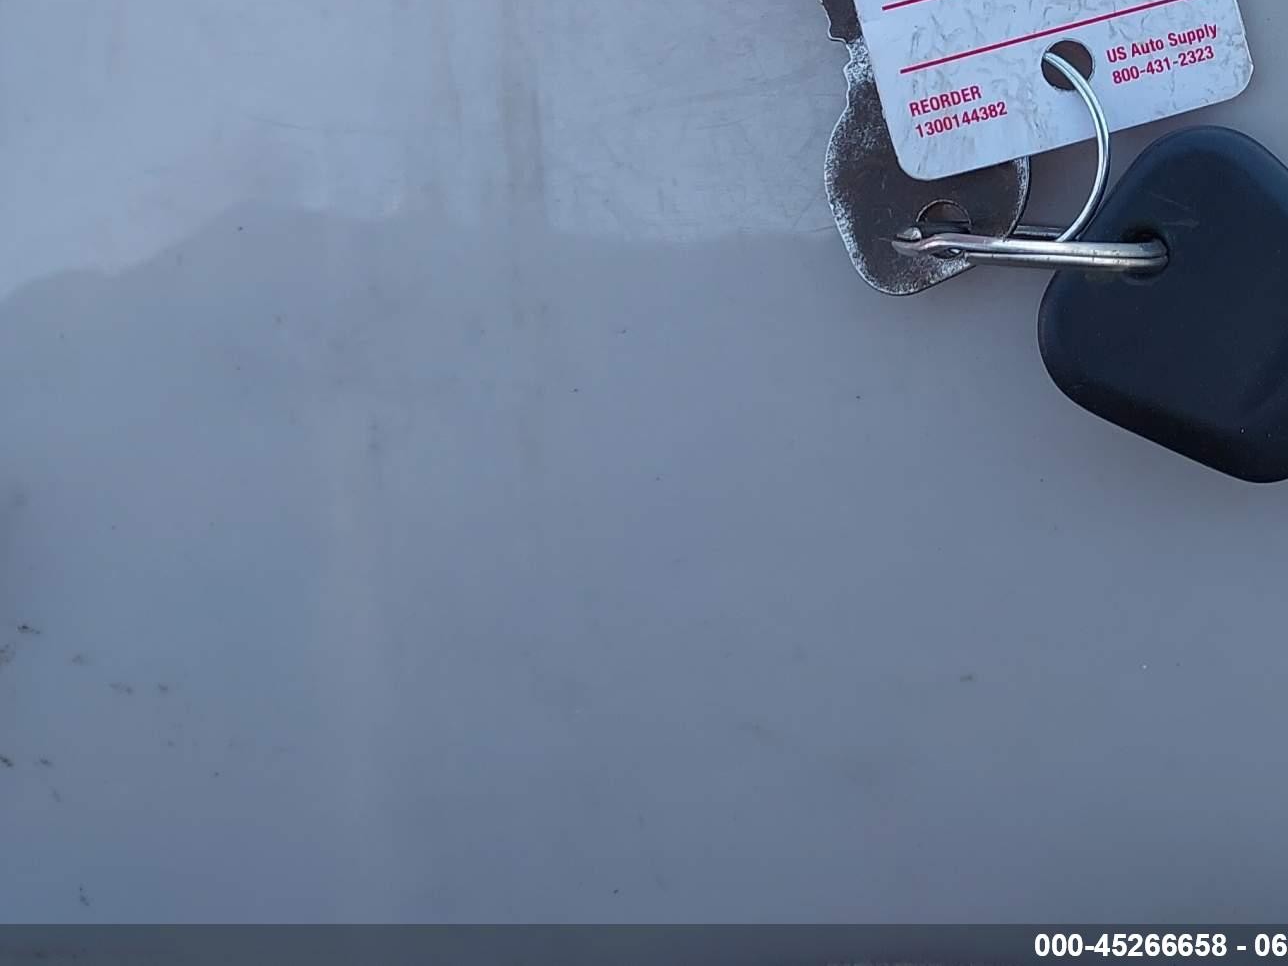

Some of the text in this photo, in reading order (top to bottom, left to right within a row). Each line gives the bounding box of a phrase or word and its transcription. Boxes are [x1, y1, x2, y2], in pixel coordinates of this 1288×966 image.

[1107, 23, 1220, 64] US Auto Supply
[1112, 45, 1216, 85] 800-431-2323
[909, 86, 983, 117] REORDER
[916, 102, 1008, 138] 1300144382
